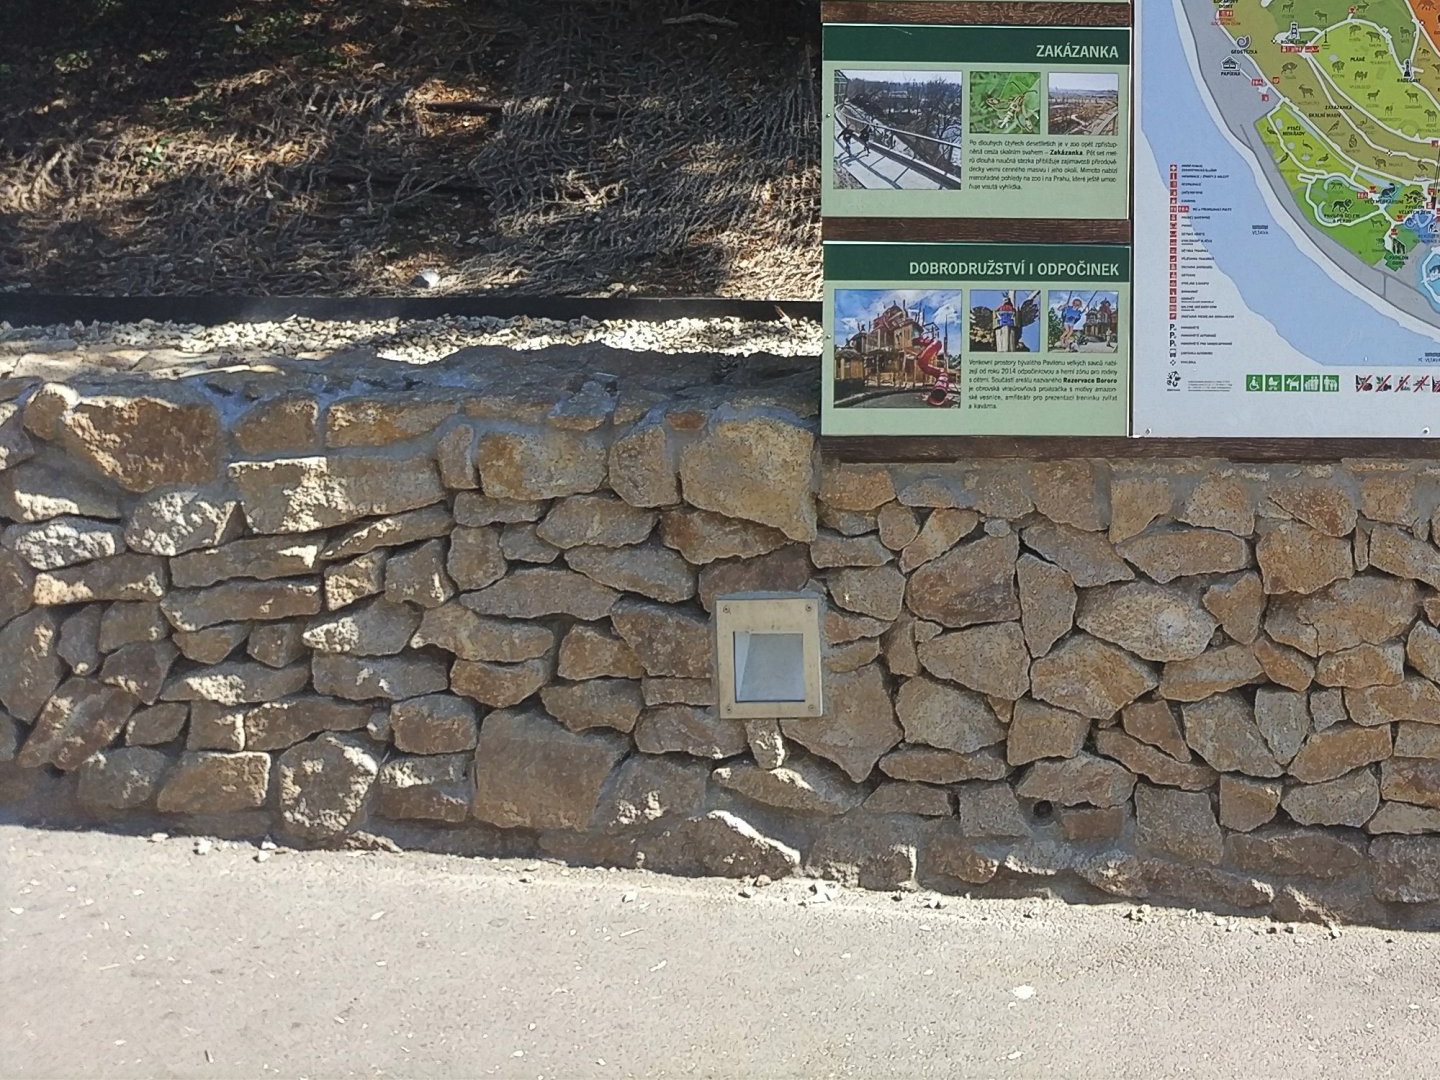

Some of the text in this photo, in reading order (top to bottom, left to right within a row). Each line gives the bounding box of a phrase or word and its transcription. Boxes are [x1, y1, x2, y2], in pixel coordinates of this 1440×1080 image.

[1036, 42, 1119, 58] ZAKÁZANKA
[909, 260, 1119, 276] DOBRODRUŽSTVÍ I ODPOČINEK
